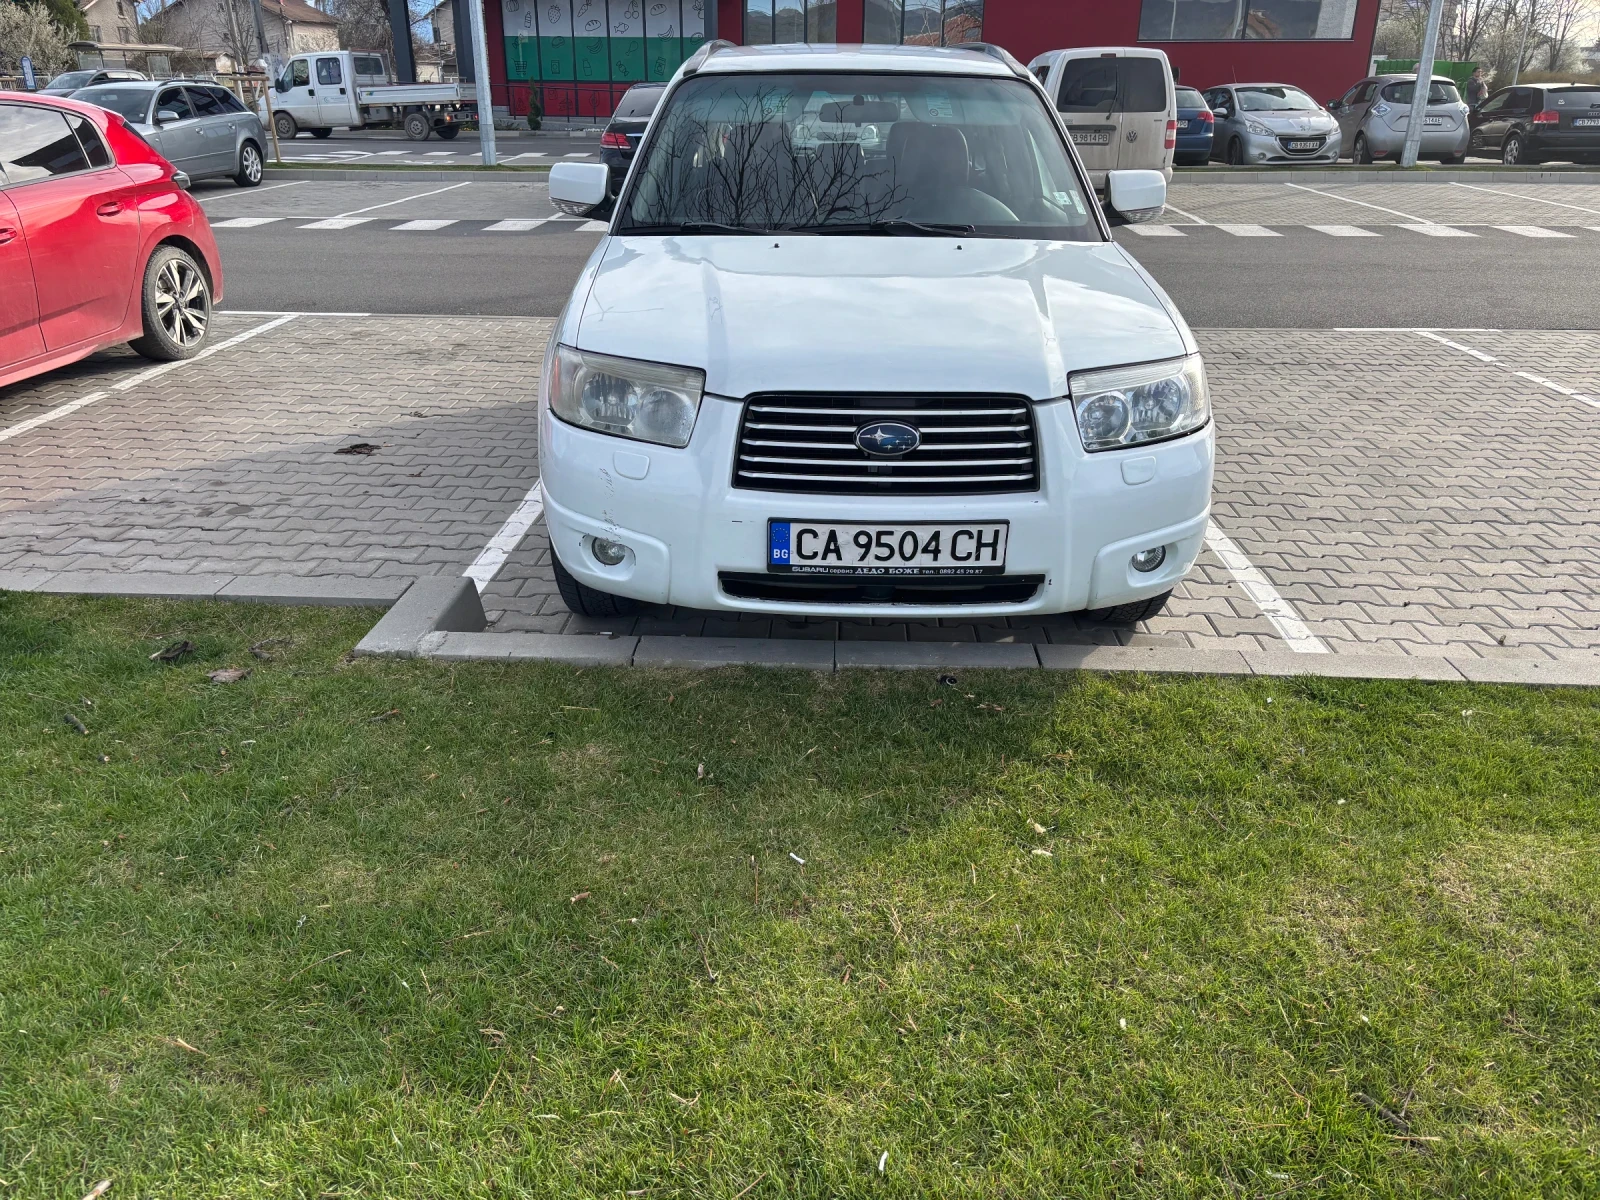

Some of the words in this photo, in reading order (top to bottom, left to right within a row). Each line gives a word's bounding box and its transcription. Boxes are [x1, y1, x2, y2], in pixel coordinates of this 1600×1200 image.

[773, 548, 788, 559] BG
[796, 528, 843, 561] CA
[853, 529, 942, 562] 9504
[950, 528, 1000, 561] CH
